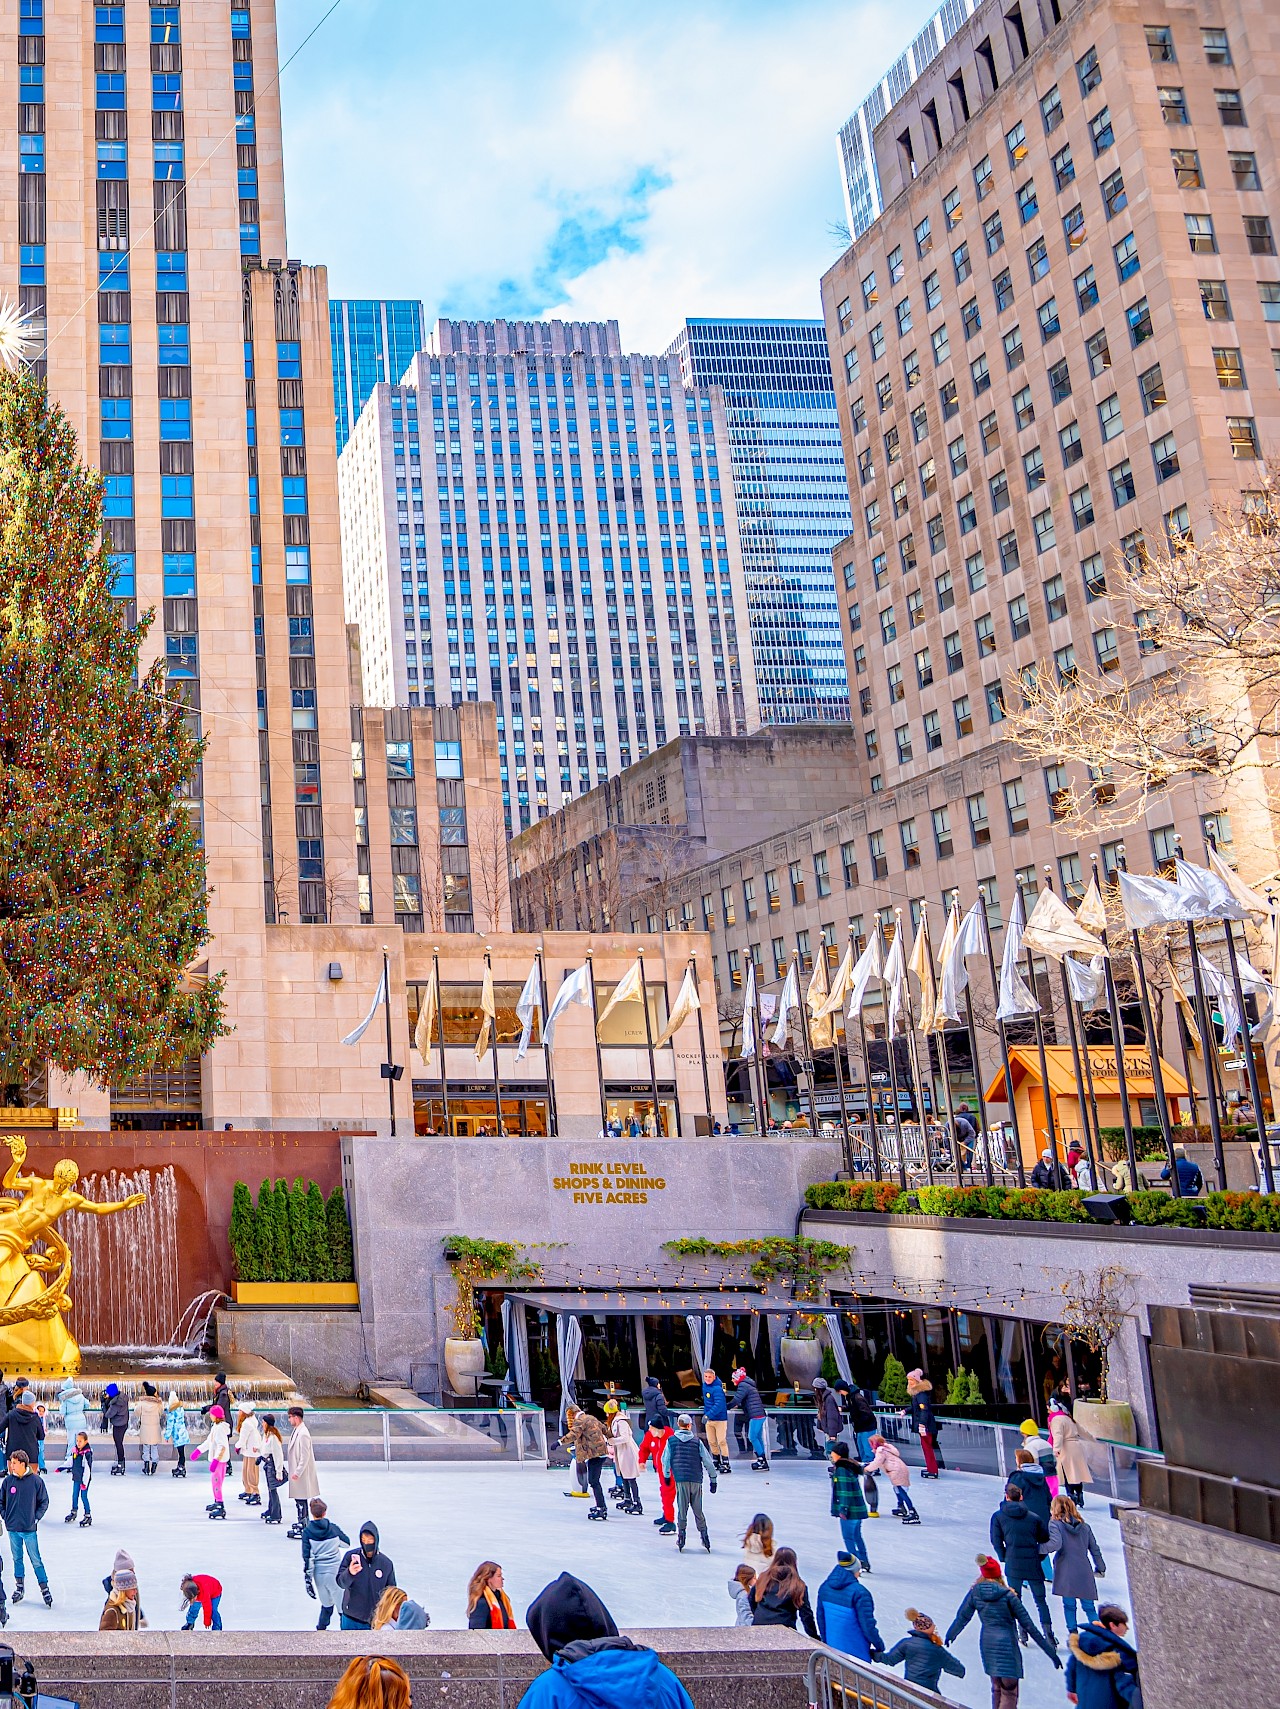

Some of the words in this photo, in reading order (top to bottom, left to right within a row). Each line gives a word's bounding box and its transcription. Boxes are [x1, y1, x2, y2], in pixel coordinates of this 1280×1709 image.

[569, 1163, 604, 1174] RINK
[606, 1163, 647, 1174] LEVEL
[553, 1178, 600, 1189] SHOPS
[602, 1178, 613, 1189] &
[616, 1178, 666, 1189] DINING
[573, 1192, 603, 1204] FIVE
[605, 1192, 648, 1204] ACRES
